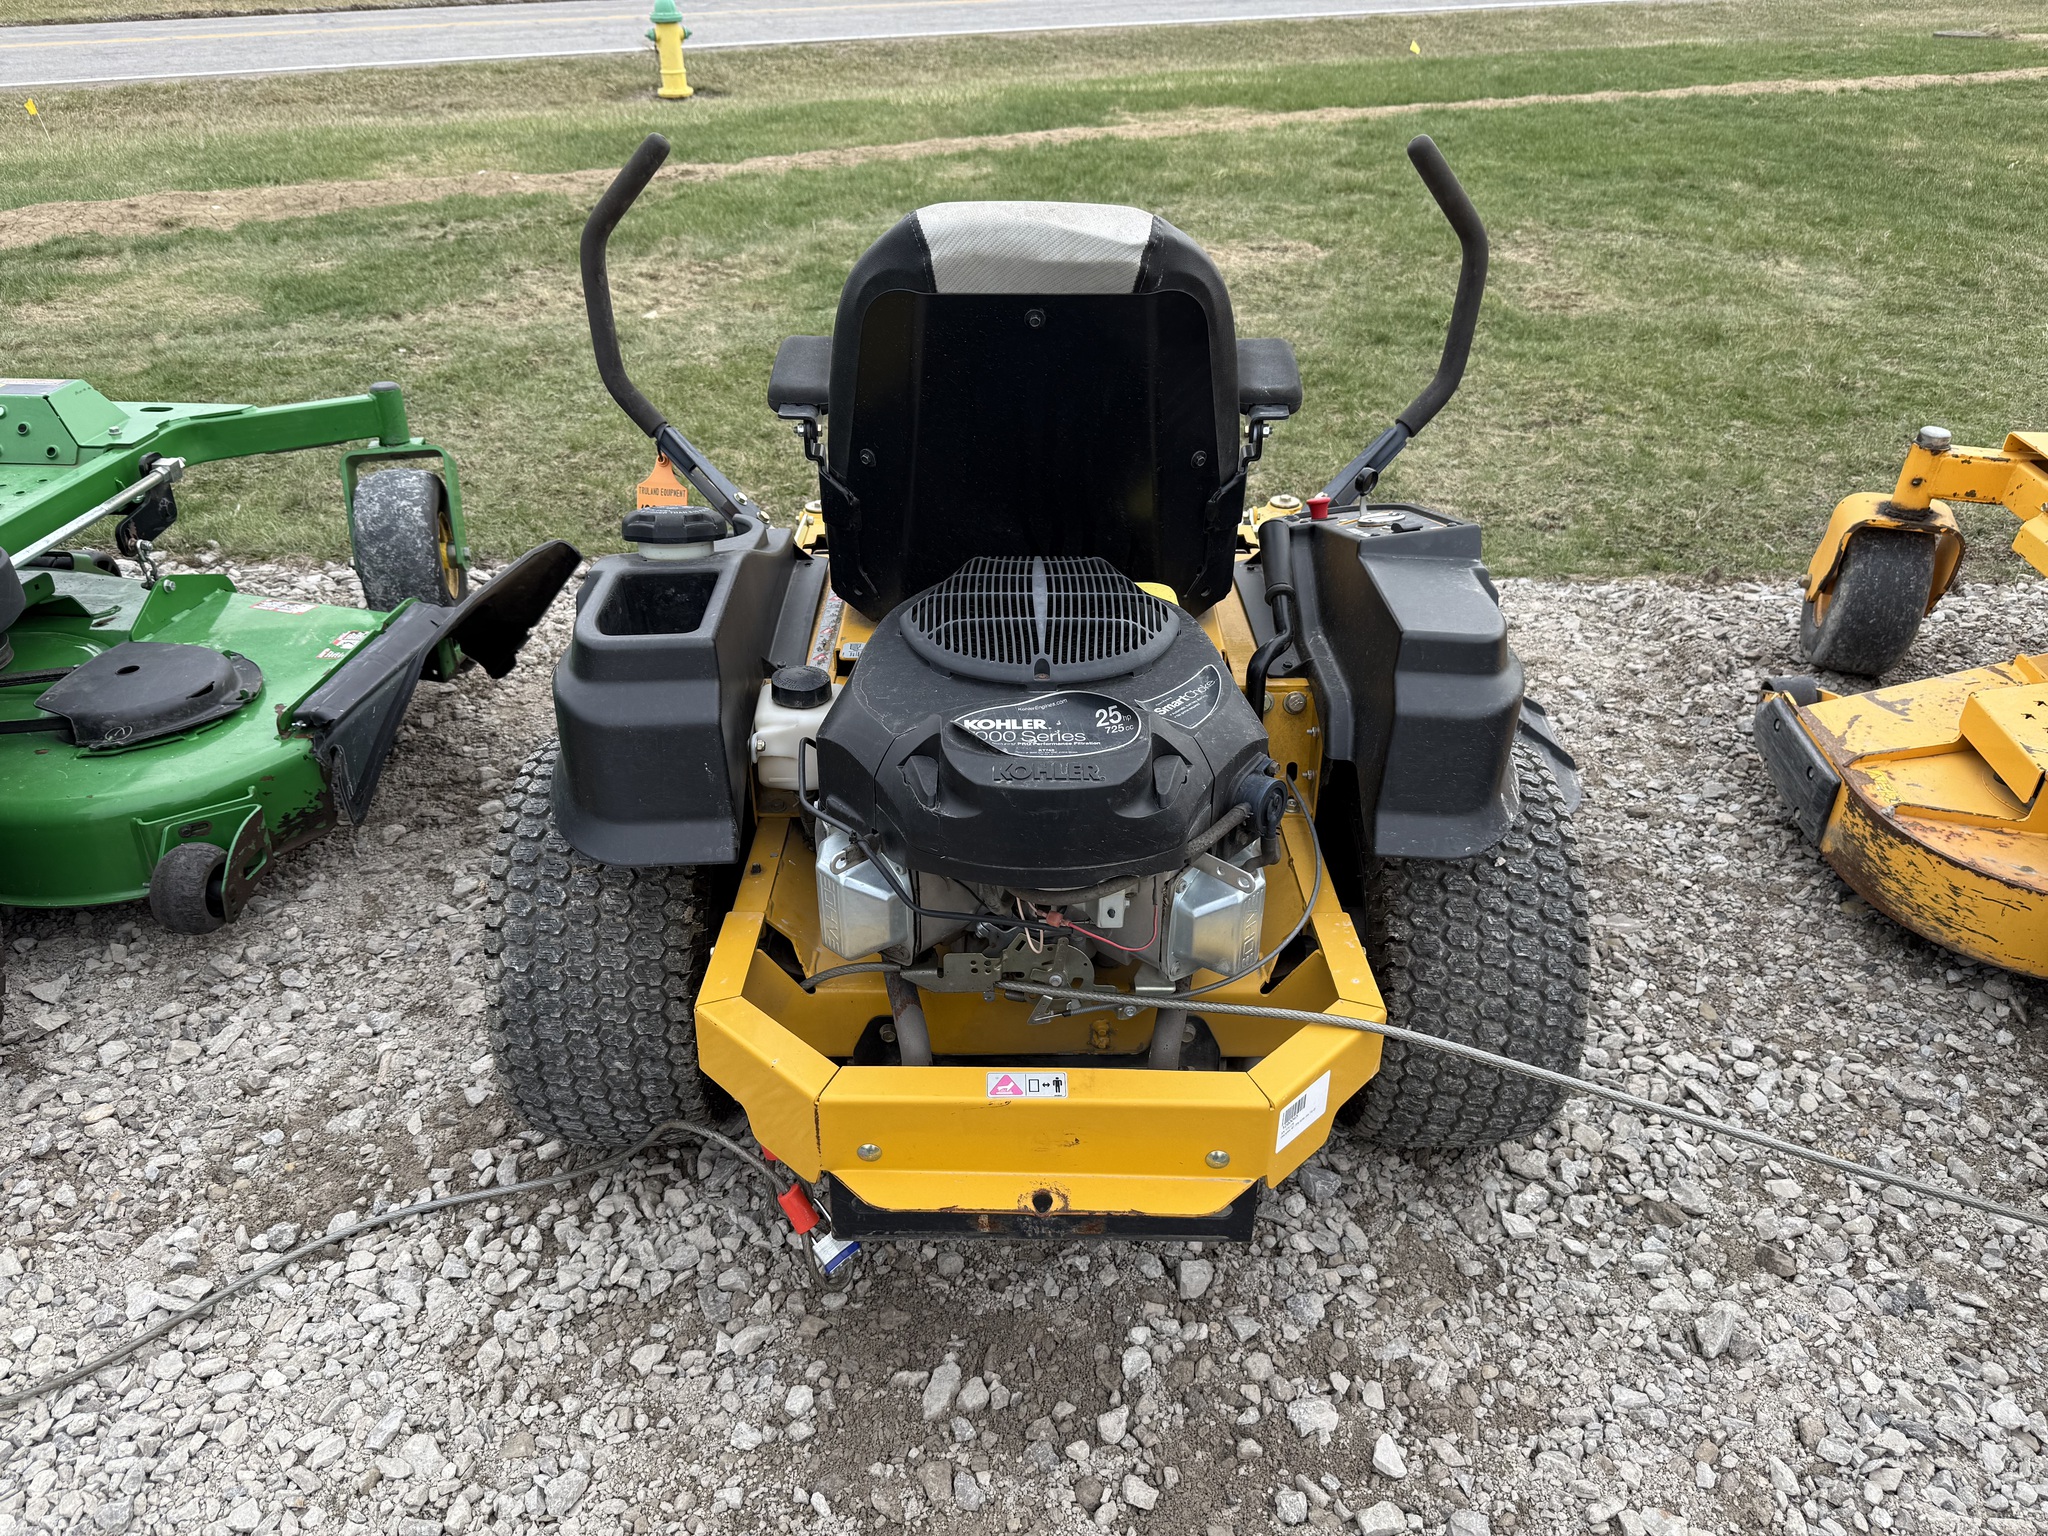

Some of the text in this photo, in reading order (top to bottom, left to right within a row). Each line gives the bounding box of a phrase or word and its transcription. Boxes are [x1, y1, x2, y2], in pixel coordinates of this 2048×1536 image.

[660, 487, 686, 498] EQUIPMENT
[1153, 680, 1216, 715] SmartChoke
[1095, 705, 1122, 727] 25
[1105, 723, 1124, 734] 725
[972, 730, 1086, 742] 000 Series
